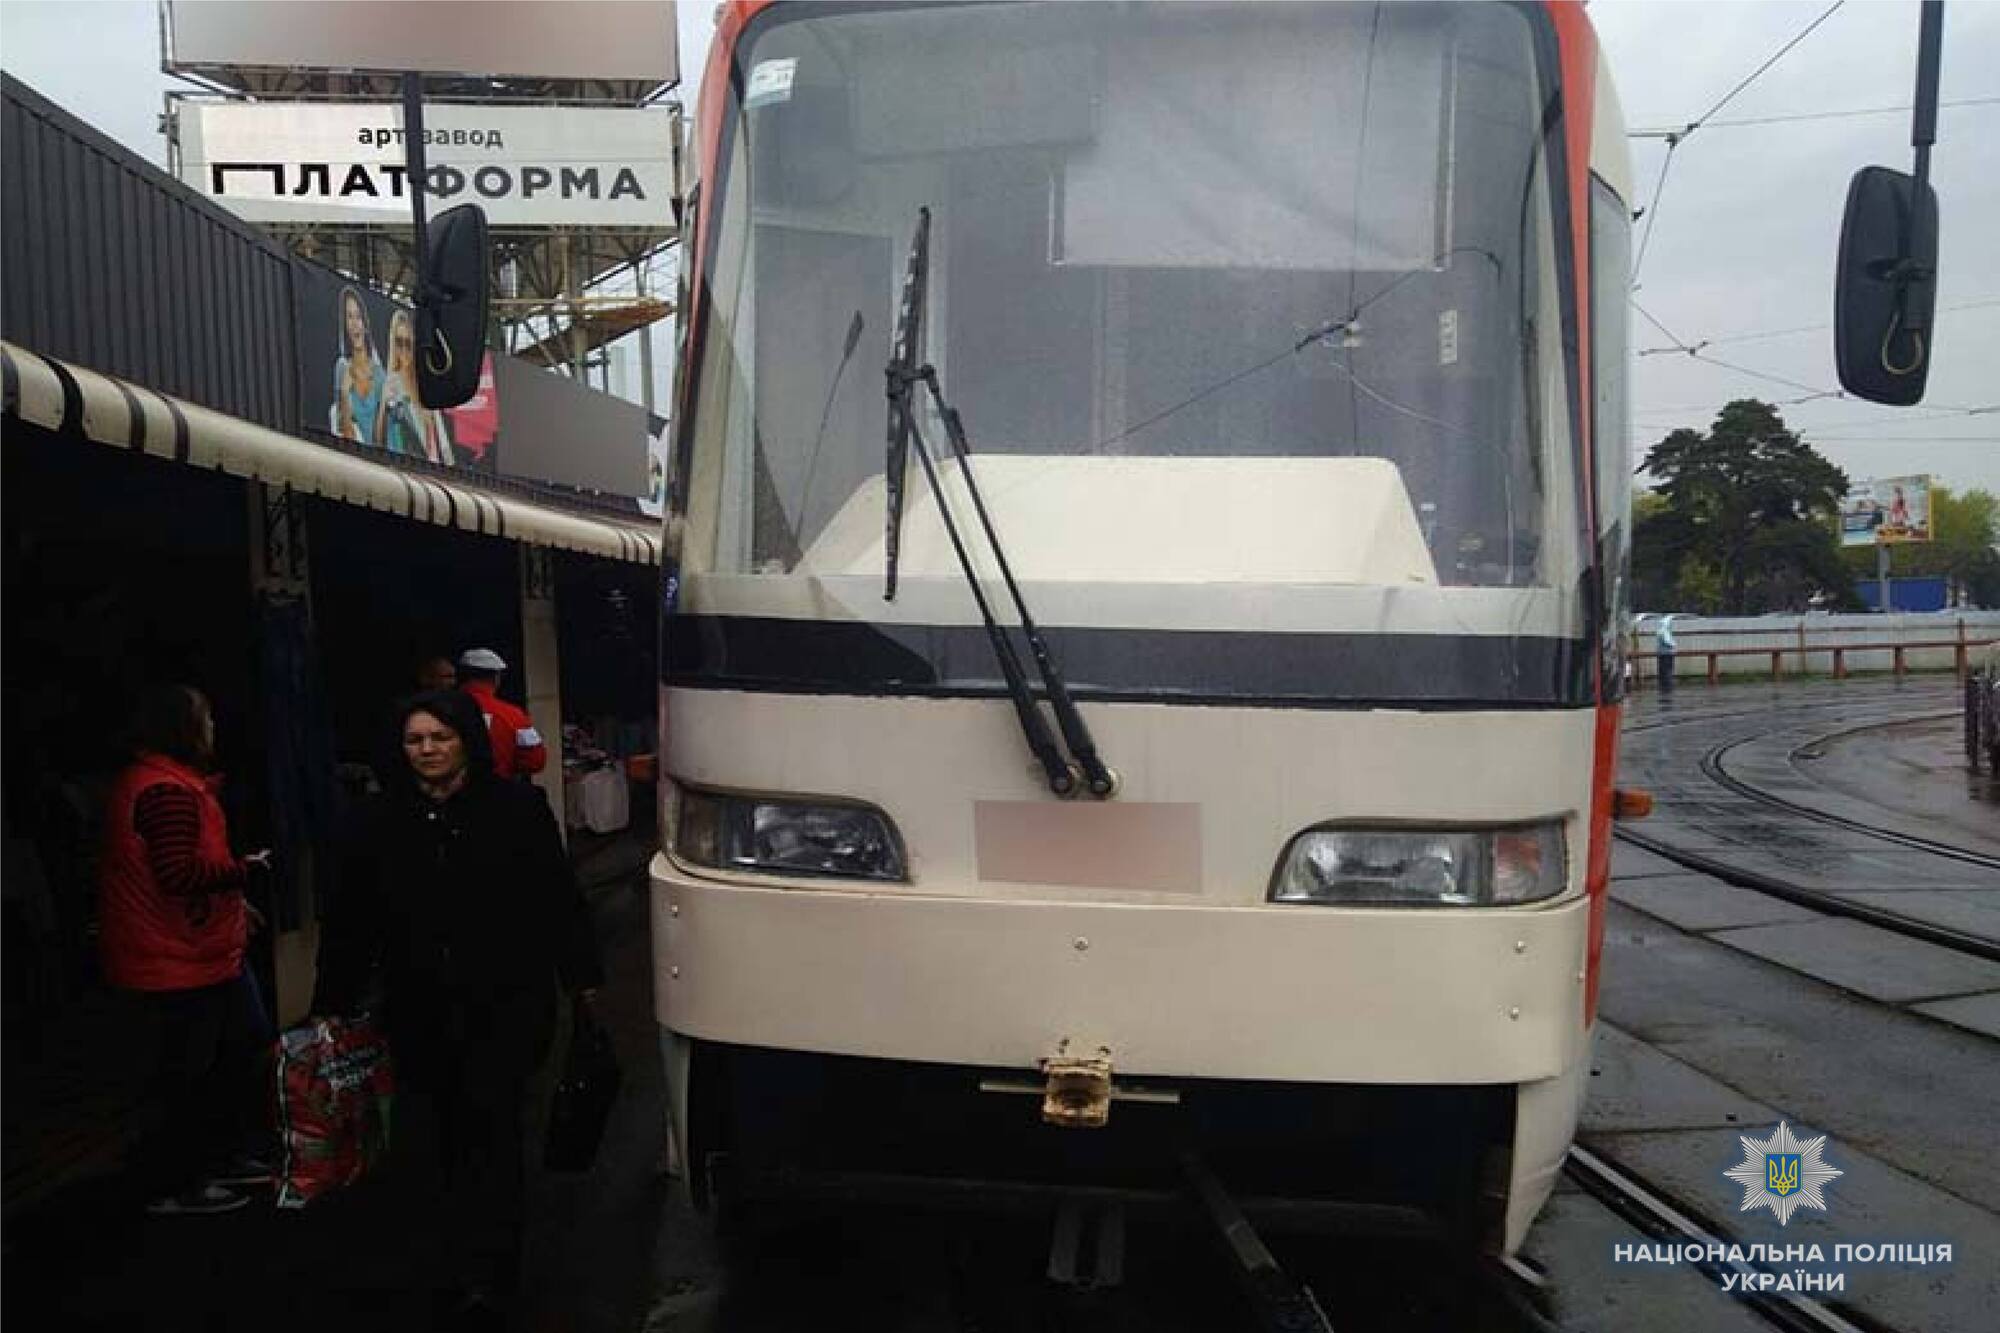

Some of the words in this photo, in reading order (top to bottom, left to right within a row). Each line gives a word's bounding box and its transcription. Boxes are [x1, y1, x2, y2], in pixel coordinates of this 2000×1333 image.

[358, 127, 406, 149] арт
[421, 129, 503, 149] завод
[212, 163, 646, 200] ПЛАТФОРМА
